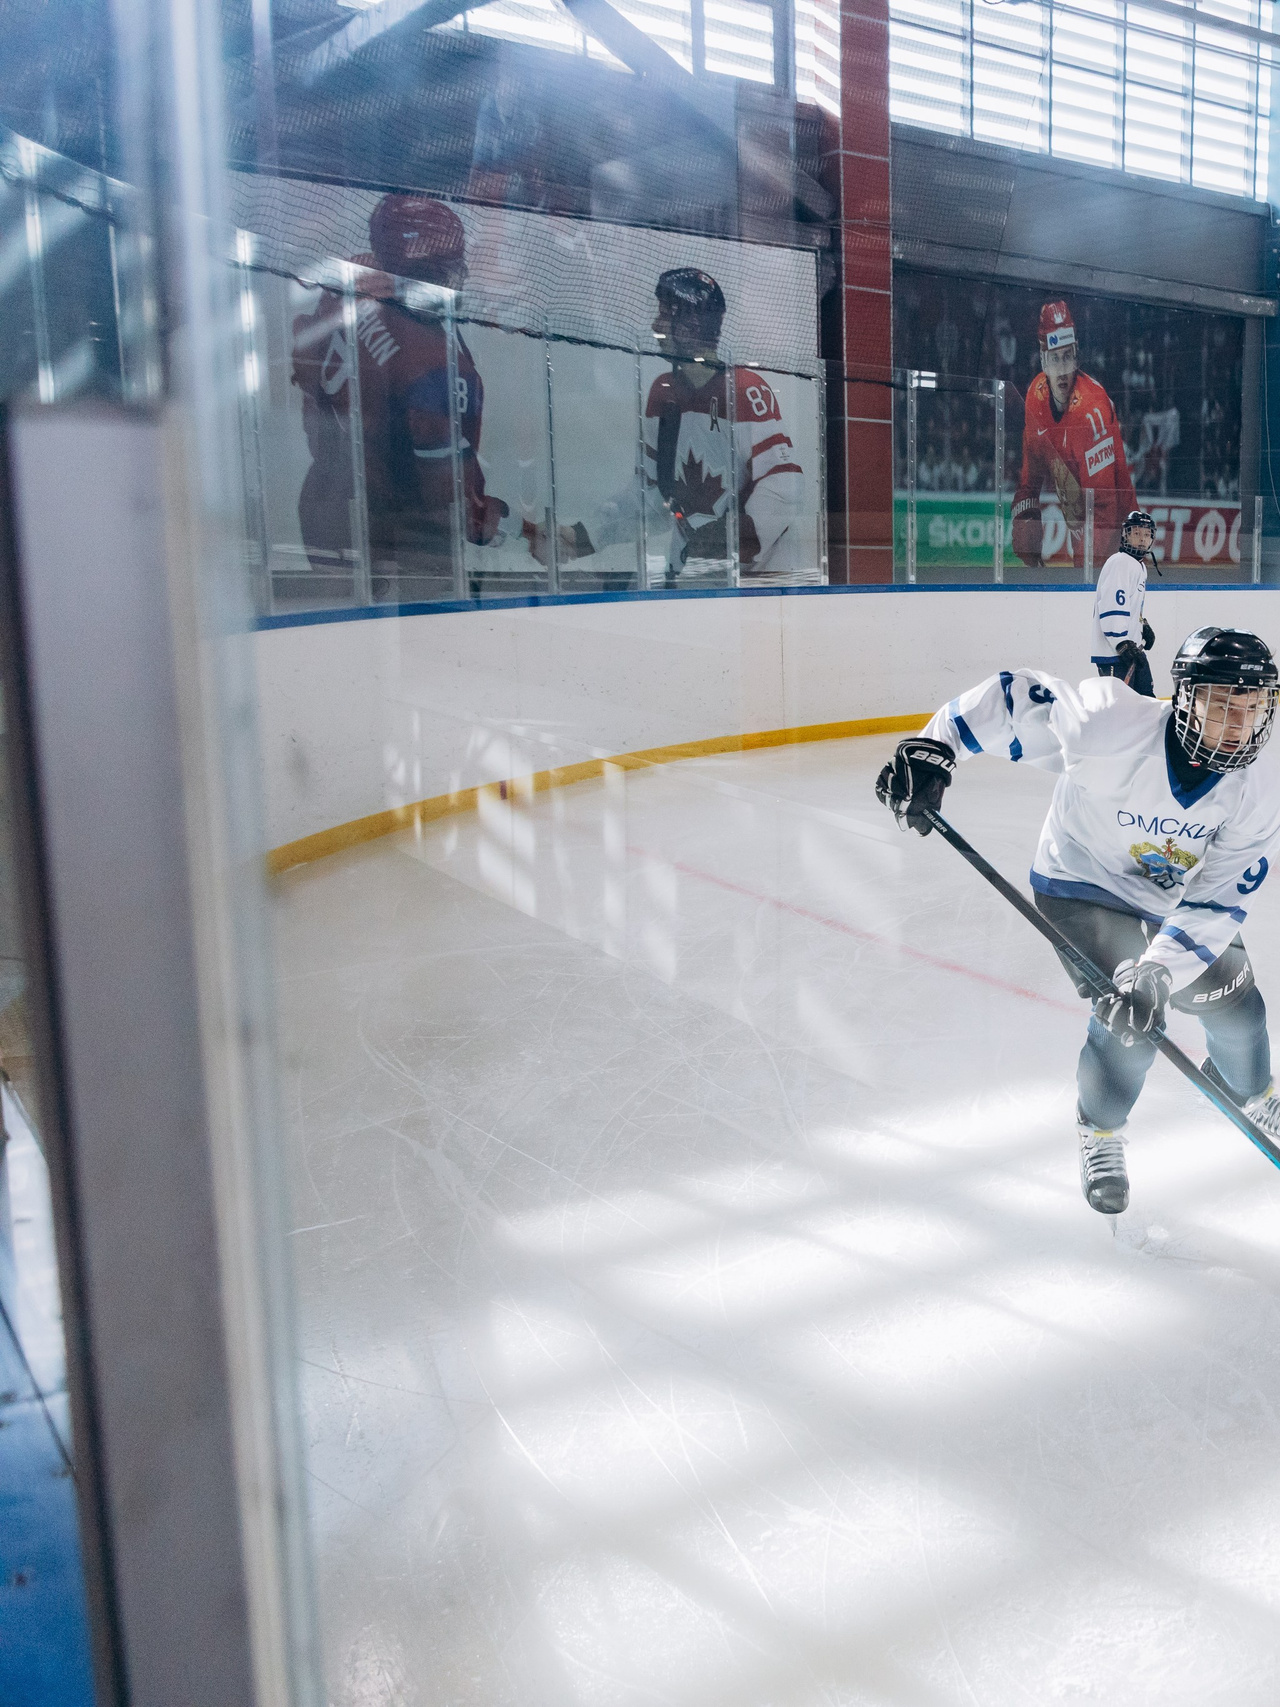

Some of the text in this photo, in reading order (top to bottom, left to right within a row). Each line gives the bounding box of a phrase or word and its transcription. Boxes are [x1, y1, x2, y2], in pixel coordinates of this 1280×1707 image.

[745, 385, 775, 417] 87
[1085, 407, 1107, 441] 11
[1115, 589, 1127, 606] 6
[1240, 663, 1264, 672] EFSI
[909, 749, 957, 773] BAU
[1236, 856, 1269, 895] 9
[1191, 961, 1251, 1004] BAUER
